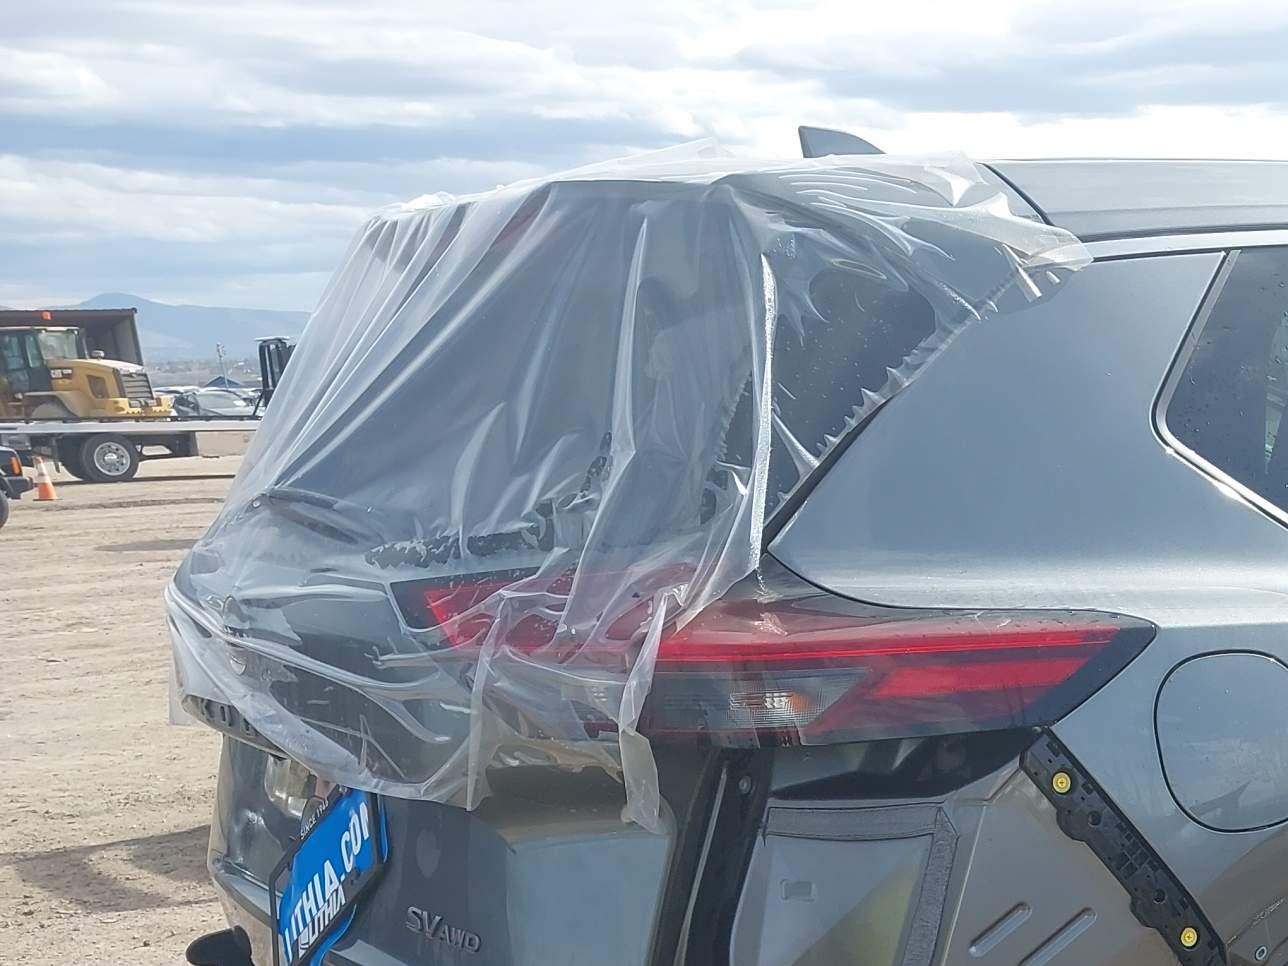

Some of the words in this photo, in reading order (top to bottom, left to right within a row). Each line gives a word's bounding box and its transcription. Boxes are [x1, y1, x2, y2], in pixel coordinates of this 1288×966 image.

[300, 812, 317, 840] SINCE
[405, 906, 442, 940] SV
[440, 924, 482, 954] AWD
